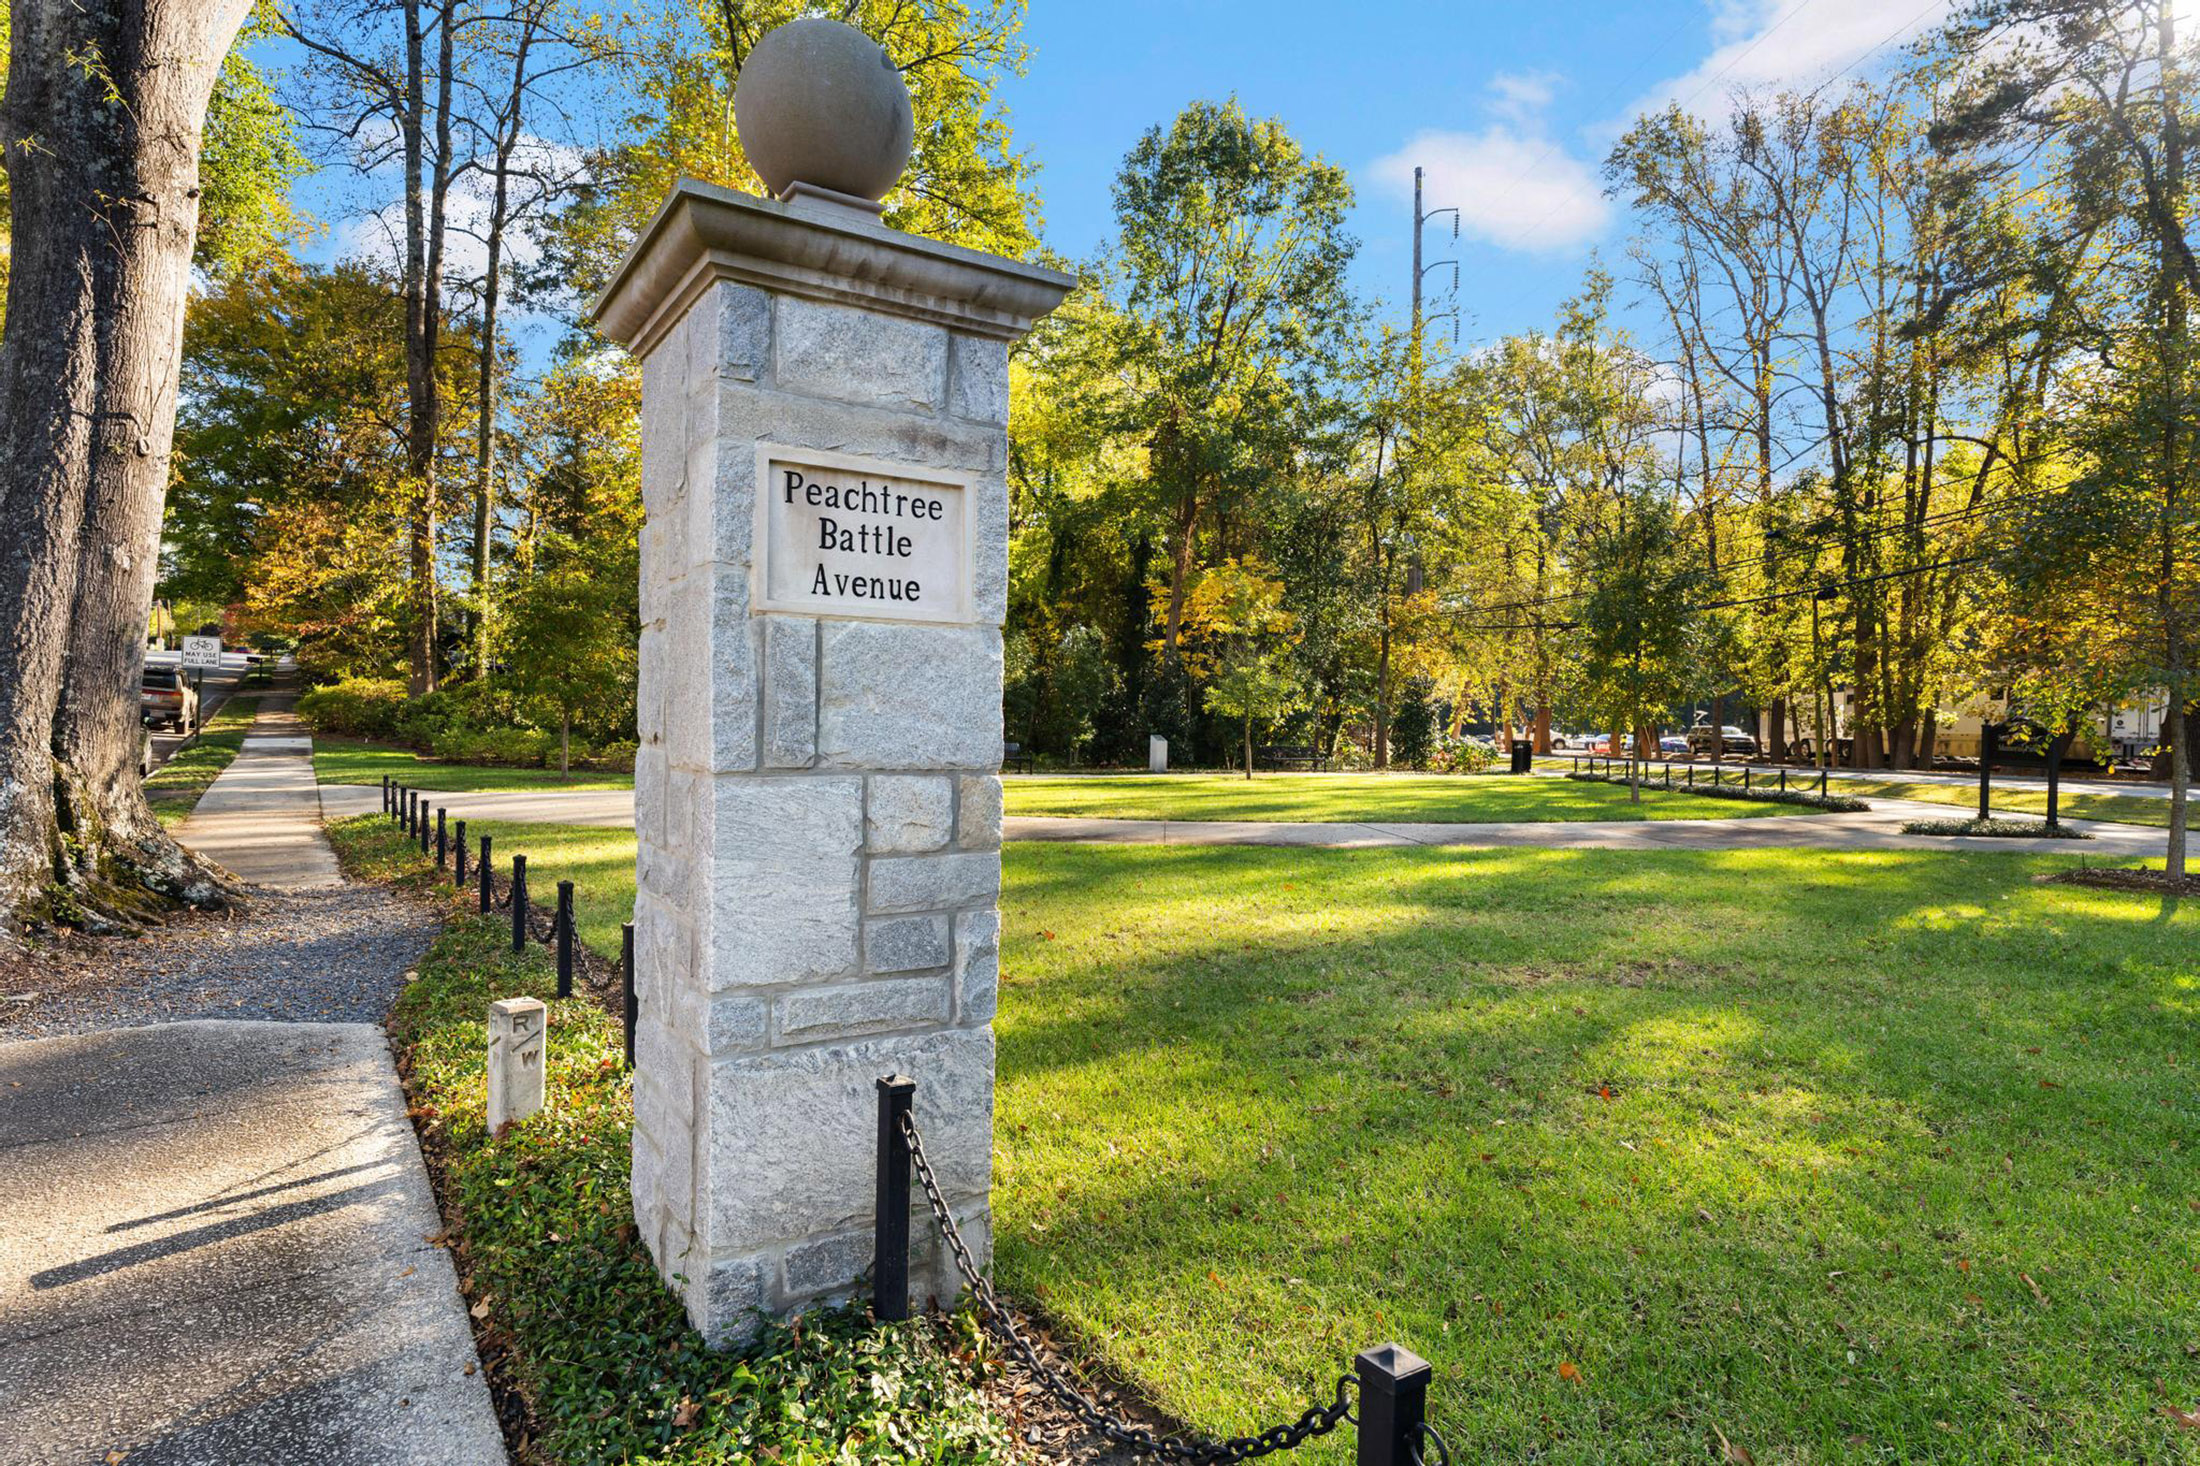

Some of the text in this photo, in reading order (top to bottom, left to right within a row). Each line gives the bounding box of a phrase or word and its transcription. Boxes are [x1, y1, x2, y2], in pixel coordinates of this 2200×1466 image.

[784, 470, 943, 520] Peachtree
[818, 517, 913, 558] Battle
[811, 563, 921, 602] Avenue
[513, 1015, 530, 1033] R
[522, 1049, 540, 1068] W
